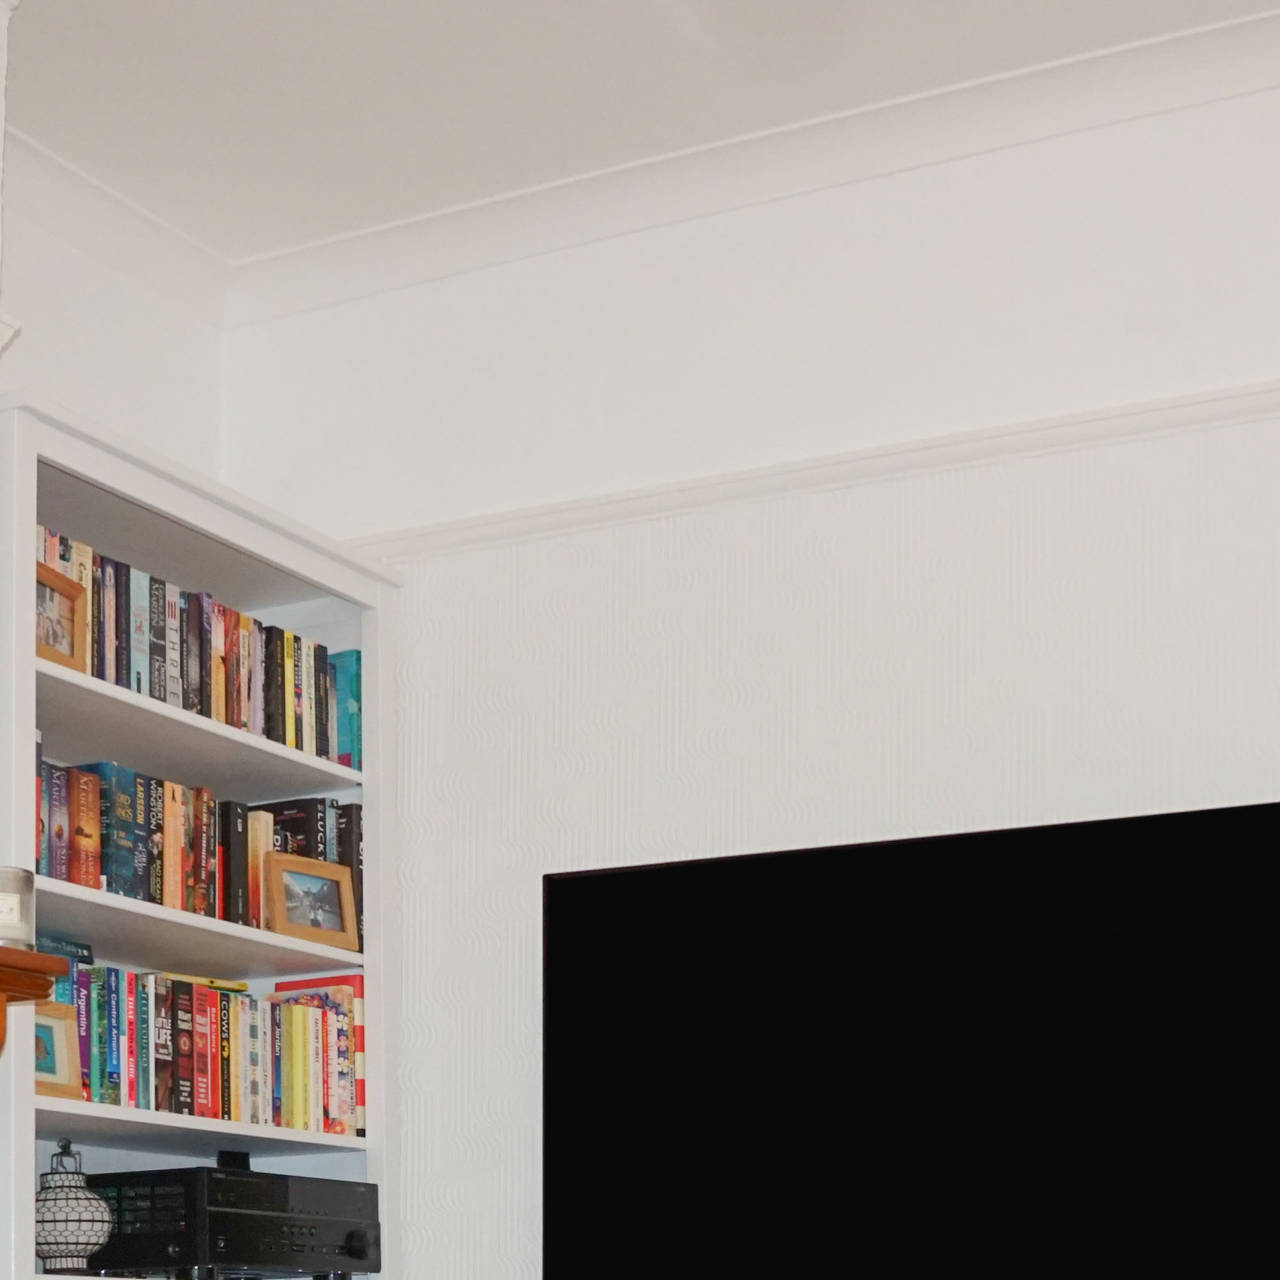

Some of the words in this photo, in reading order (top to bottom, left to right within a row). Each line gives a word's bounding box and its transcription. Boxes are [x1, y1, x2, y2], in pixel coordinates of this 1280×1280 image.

[169, 625, 178, 701] THREE
[135, 778, 145, 825] LARSSON
[149, 780, 157, 830] WINSTON
[317, 812, 325, 862] LUCKY
[77, 988, 88, 1036] Argentina
[221, 1001, 229, 1038] COWS
